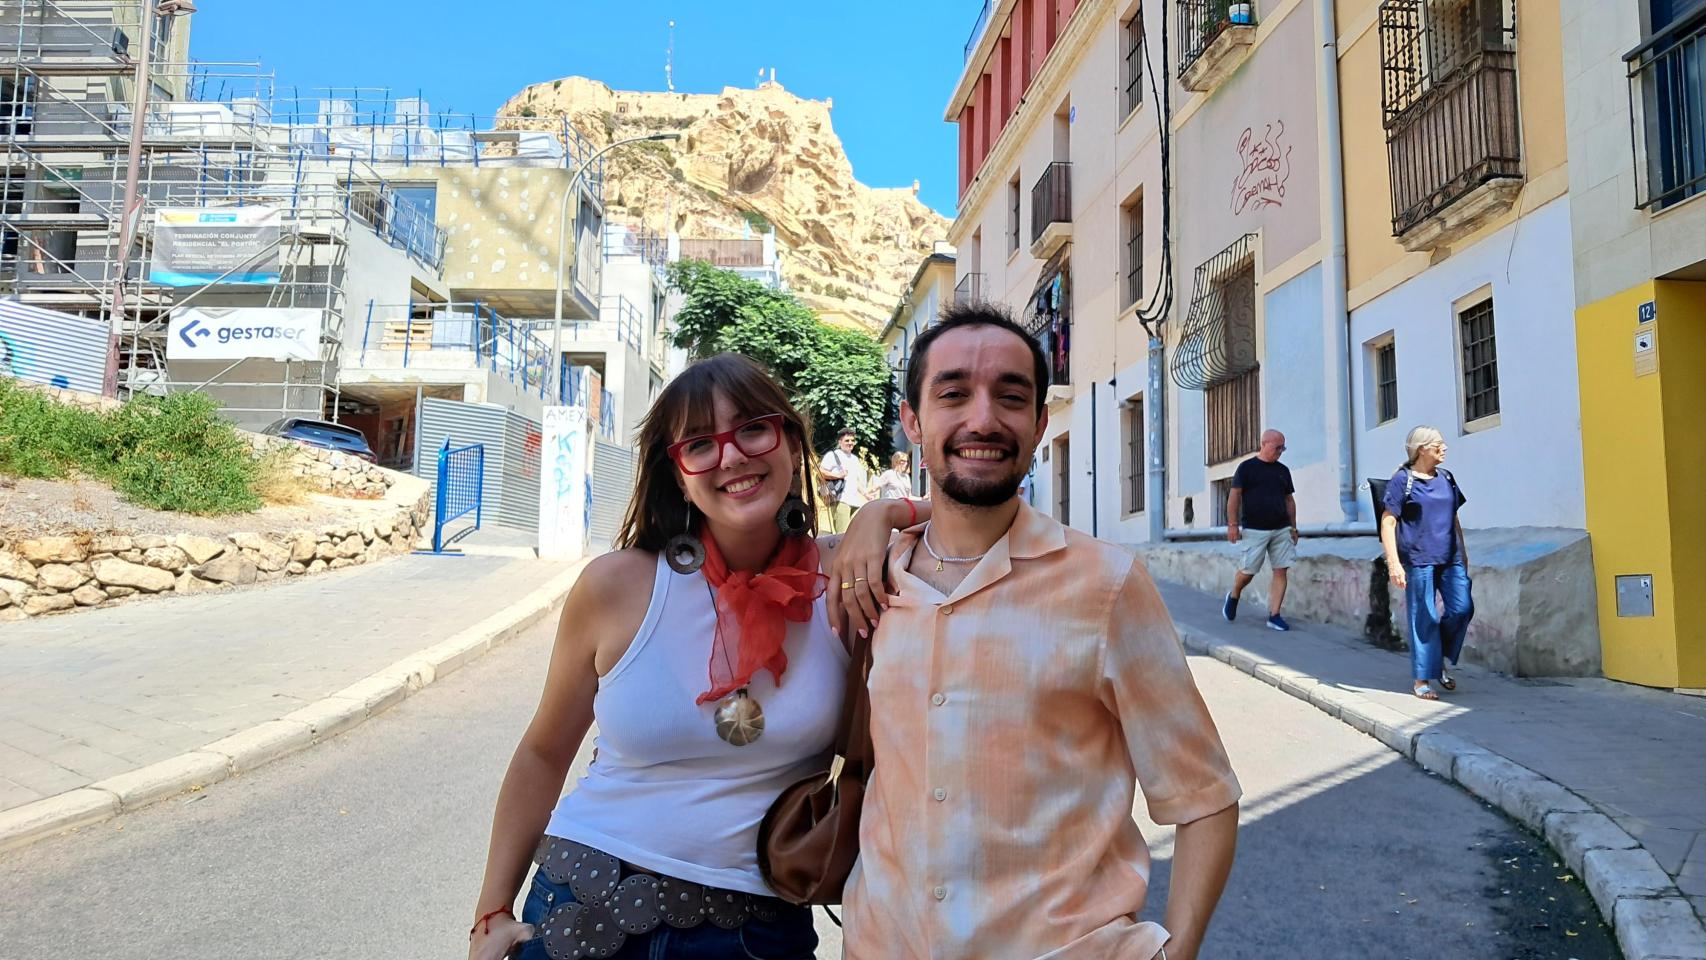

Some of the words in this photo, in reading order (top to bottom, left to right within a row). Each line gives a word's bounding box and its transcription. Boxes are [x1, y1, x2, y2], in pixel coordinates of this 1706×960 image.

[174, 232, 219, 240] TERMINACIÓN
[1641, 305, 1651, 319] 12
[546, 408, 585, 423] AMEX
